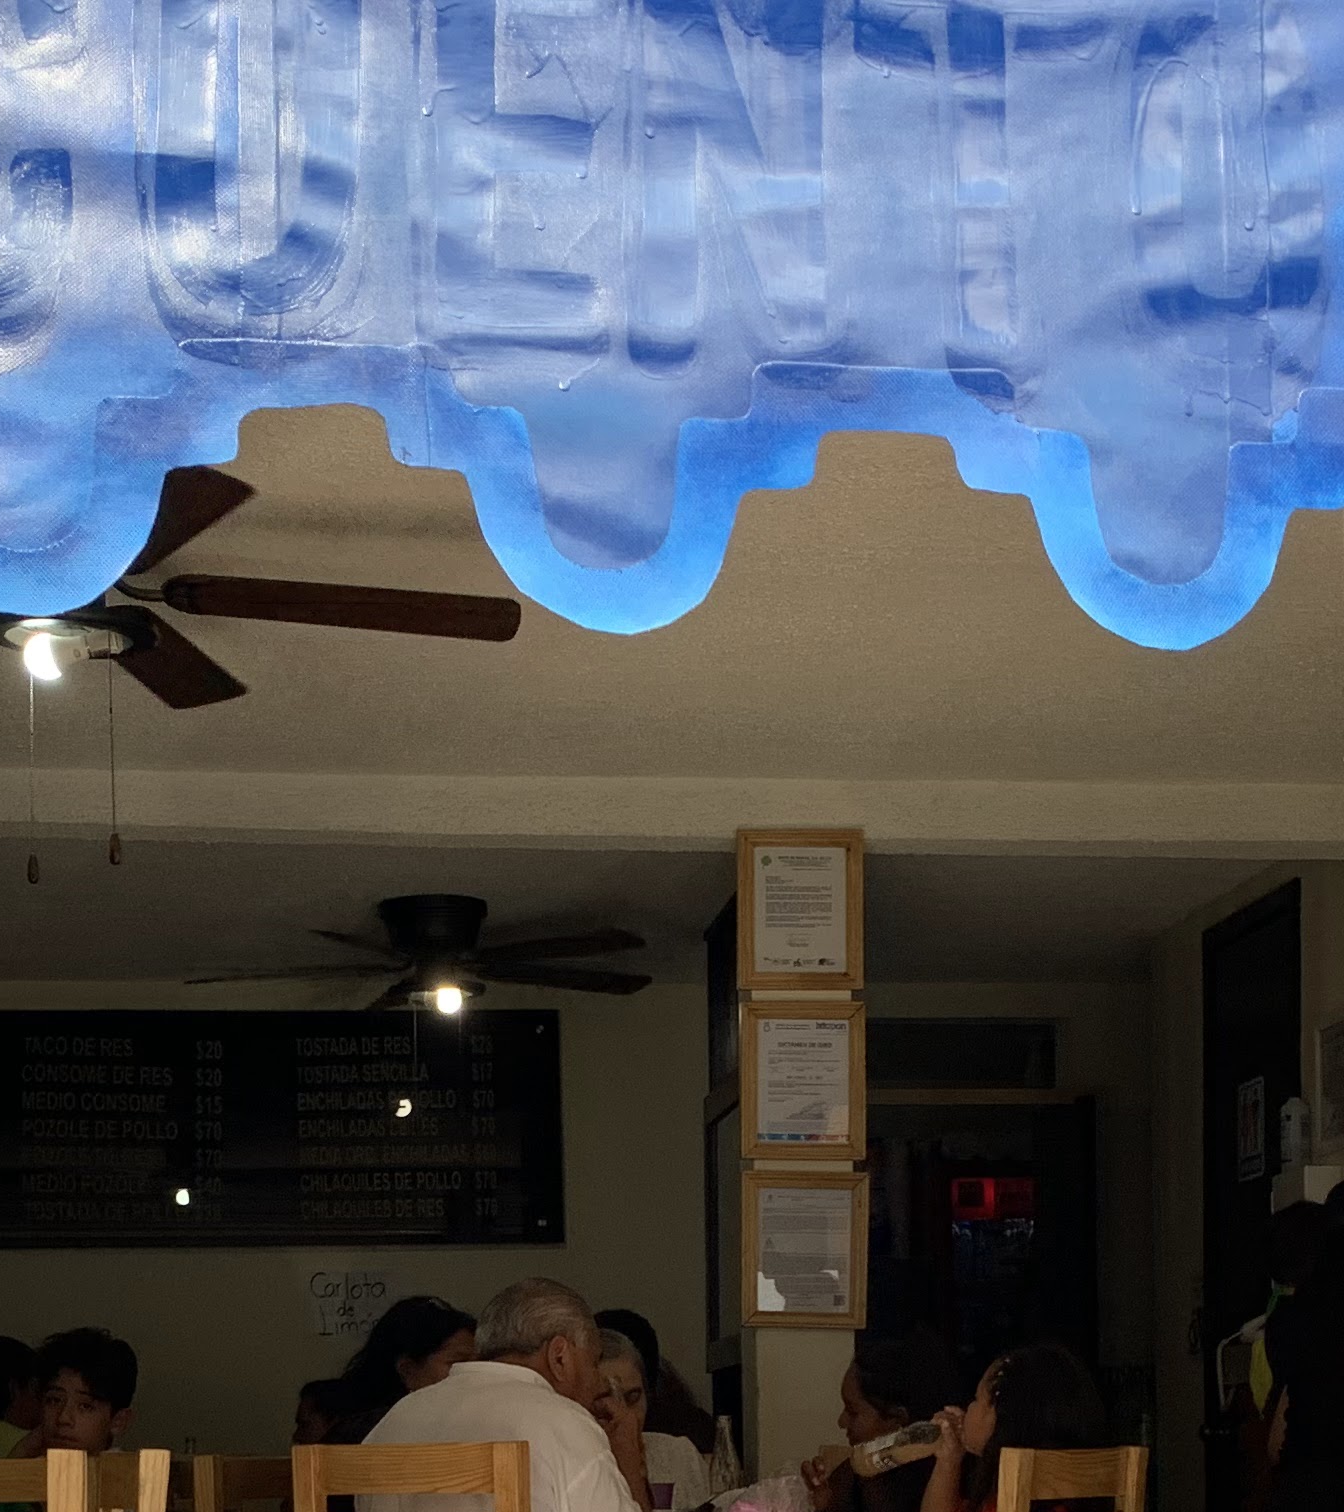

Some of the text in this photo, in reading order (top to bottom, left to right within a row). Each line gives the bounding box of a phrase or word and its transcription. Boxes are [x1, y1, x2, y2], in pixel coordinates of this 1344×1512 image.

[25, 1037, 223, 1060] TACO DE RES $20
[296, 1037, 358, 1056] TOSTADA
[362, 1037, 379, 1055] DE
[384, 1036, 411, 1055] RES
[21, 1064, 106, 1083] CONSOME
[113, 1066, 133, 1084] DE
[140, 1067, 173, 1086] RES
[297, 1065, 359, 1083] TOSTADA
[21, 1091, 76, 1110] MEDIO
[296, 1090, 384, 1111] ENCHILADAS
[22, 1118, 223, 1140] POZOLE DE POLLO $70
[298, 1119, 385, 1138] ENCHILADAS
[394, 1172, 412, 1190] DE
[416, 1170, 461, 1190] POLLO
[395, 1198, 412, 1217] DE
[417, 1198, 445, 1217] RES
[310, 1271, 386, 1300] Carlota
[337, 1300, 355, 1317] de
